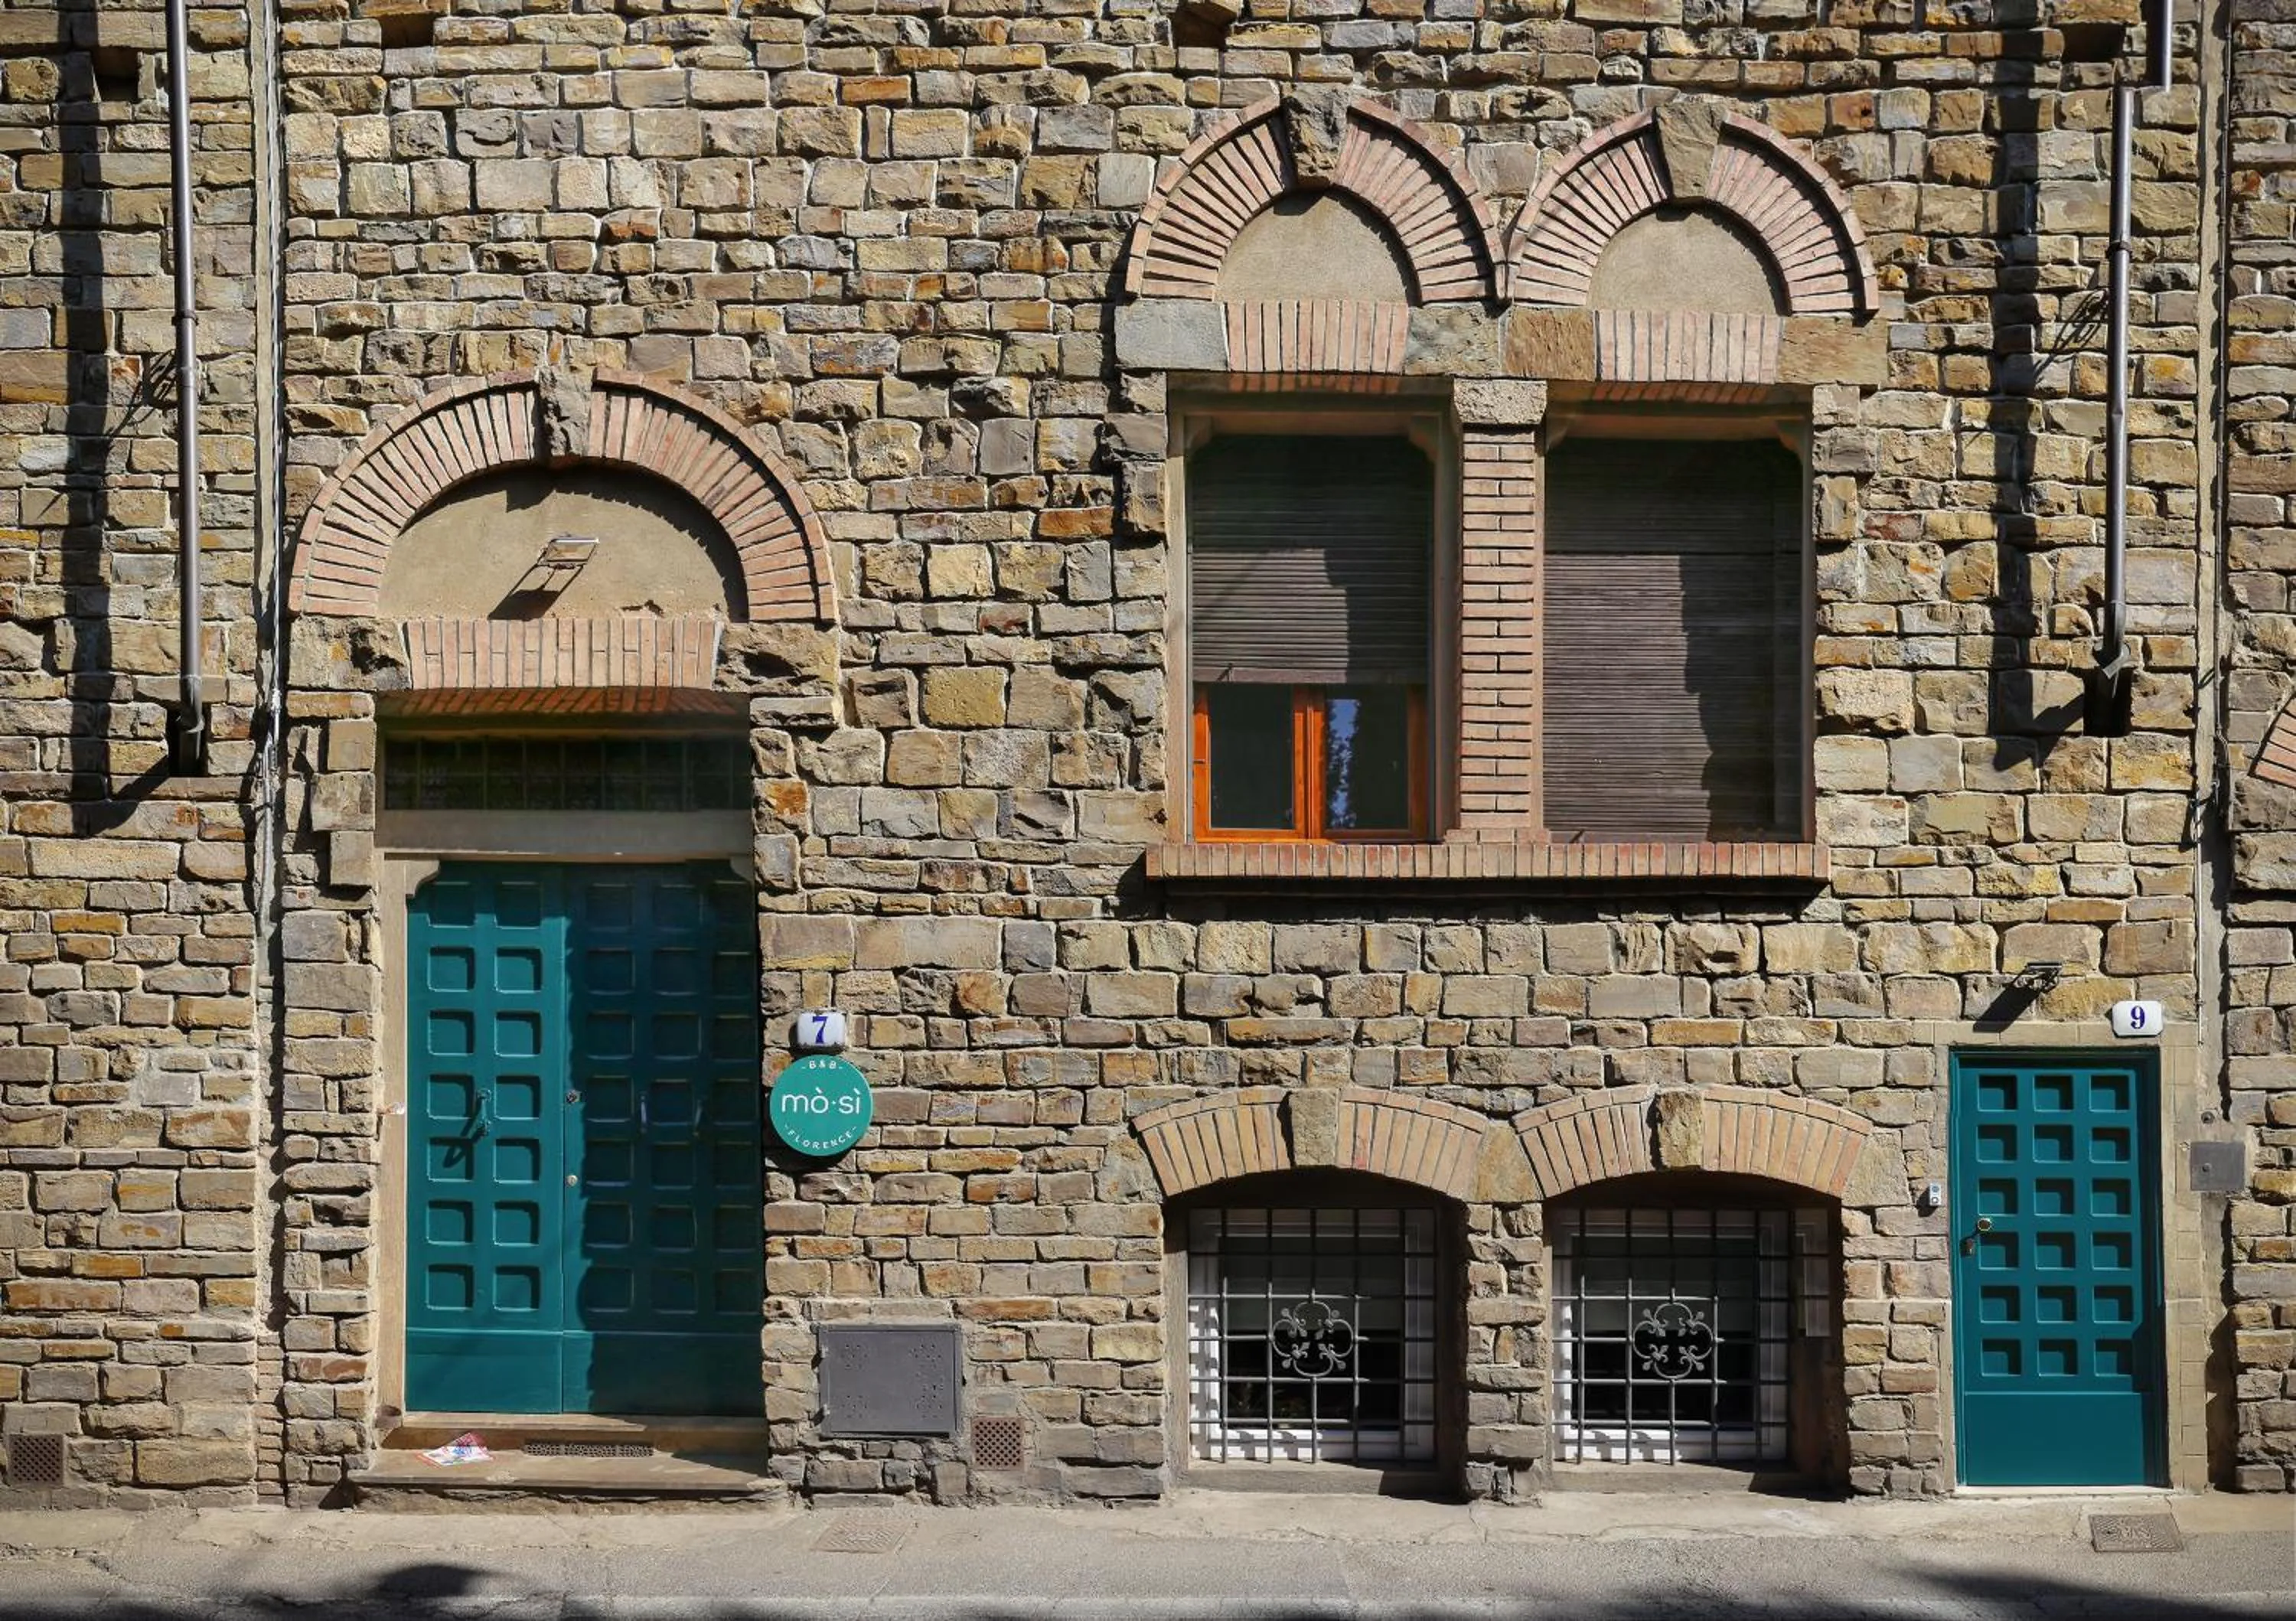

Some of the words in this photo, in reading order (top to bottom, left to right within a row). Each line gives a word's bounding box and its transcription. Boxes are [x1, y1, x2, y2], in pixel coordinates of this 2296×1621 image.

[2130, 1005, 2145, 1029] 9
[812, 1016, 829, 1044] 7
[809, 1059, 837, 1070] B&B
[788, 1130, 852, 1150] FLORENCE
